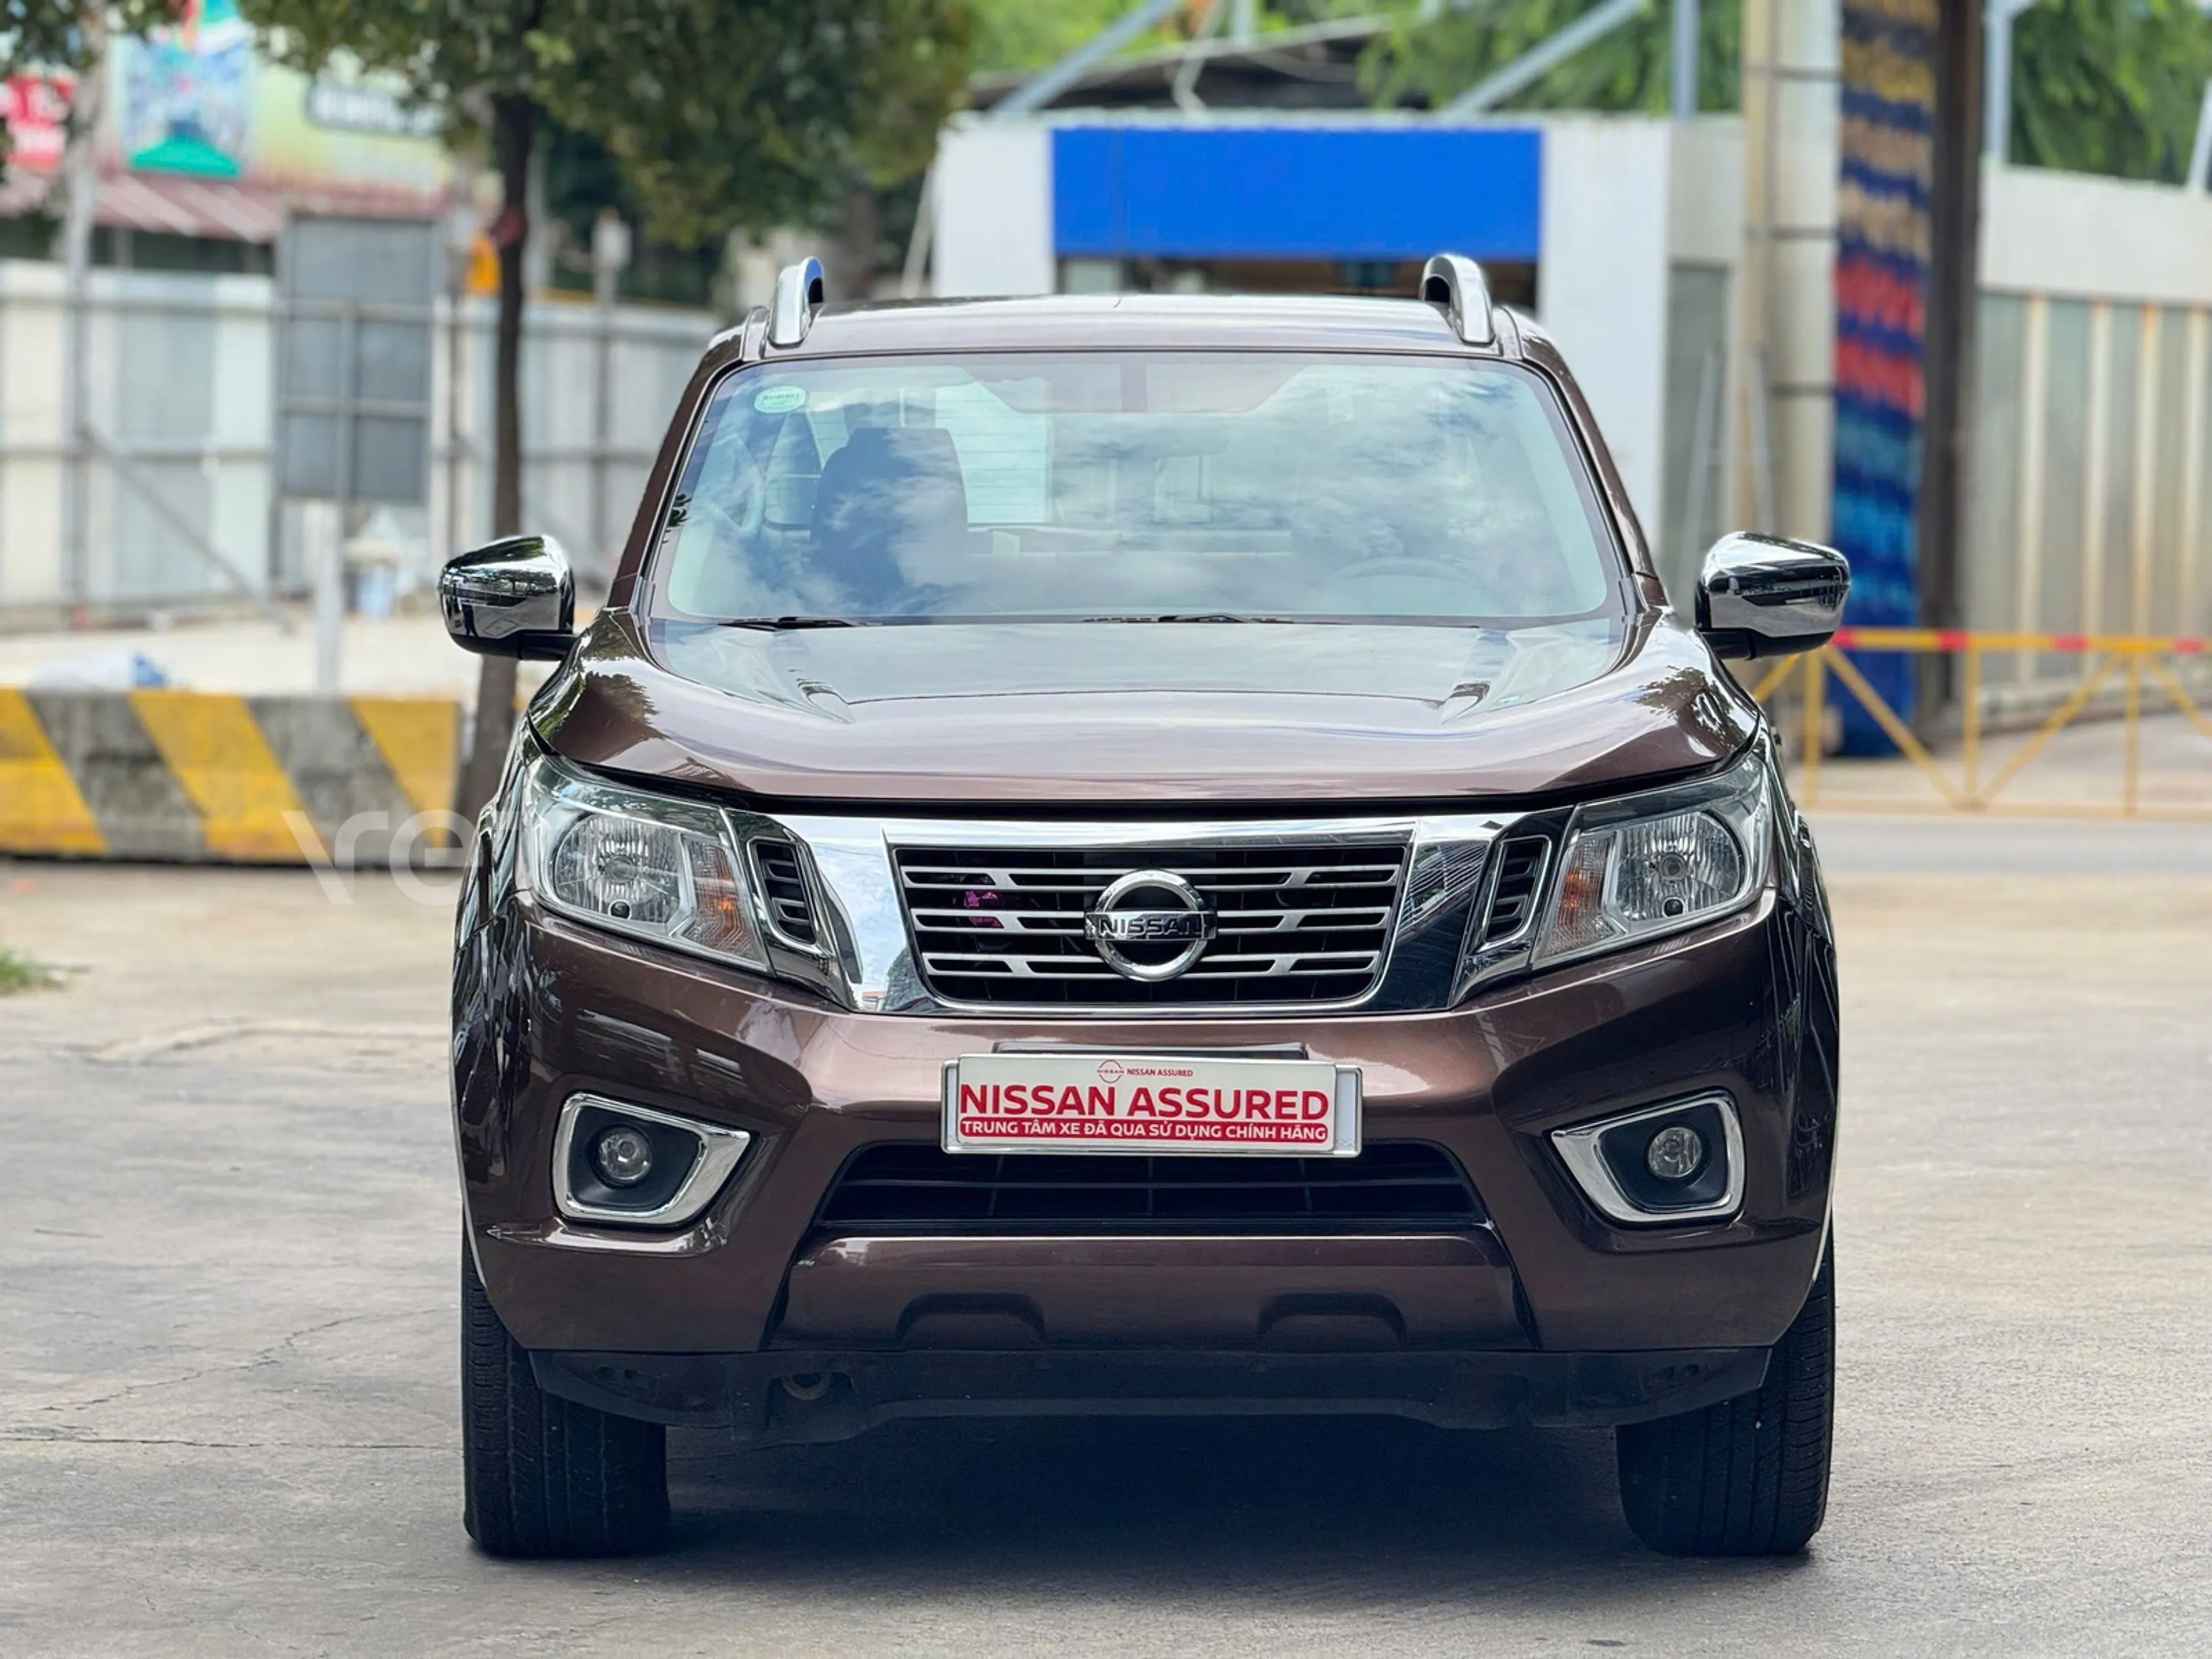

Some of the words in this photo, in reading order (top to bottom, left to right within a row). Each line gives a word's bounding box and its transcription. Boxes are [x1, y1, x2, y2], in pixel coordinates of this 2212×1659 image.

[1099, 918, 1203, 937] NISSAN
[960, 1084, 1115, 1116] NISSAN
[1127, 1087, 1329, 1120] ASSURED
[962, 1120, 1018, 1134] TRUNG
[1022, 1119, 1056, 1135] TÂM
[1059, 1123, 1080, 1135] XE
[1084, 1120, 1107, 1135] ĐÃ
[1110, 1123, 1145, 1138] QUA
[1149, 1120, 1172, 1137] SỬ
[1175, 1125, 1222, 1140] DỤNG
[1225, 1123, 1276, 1139] CHÍNH
